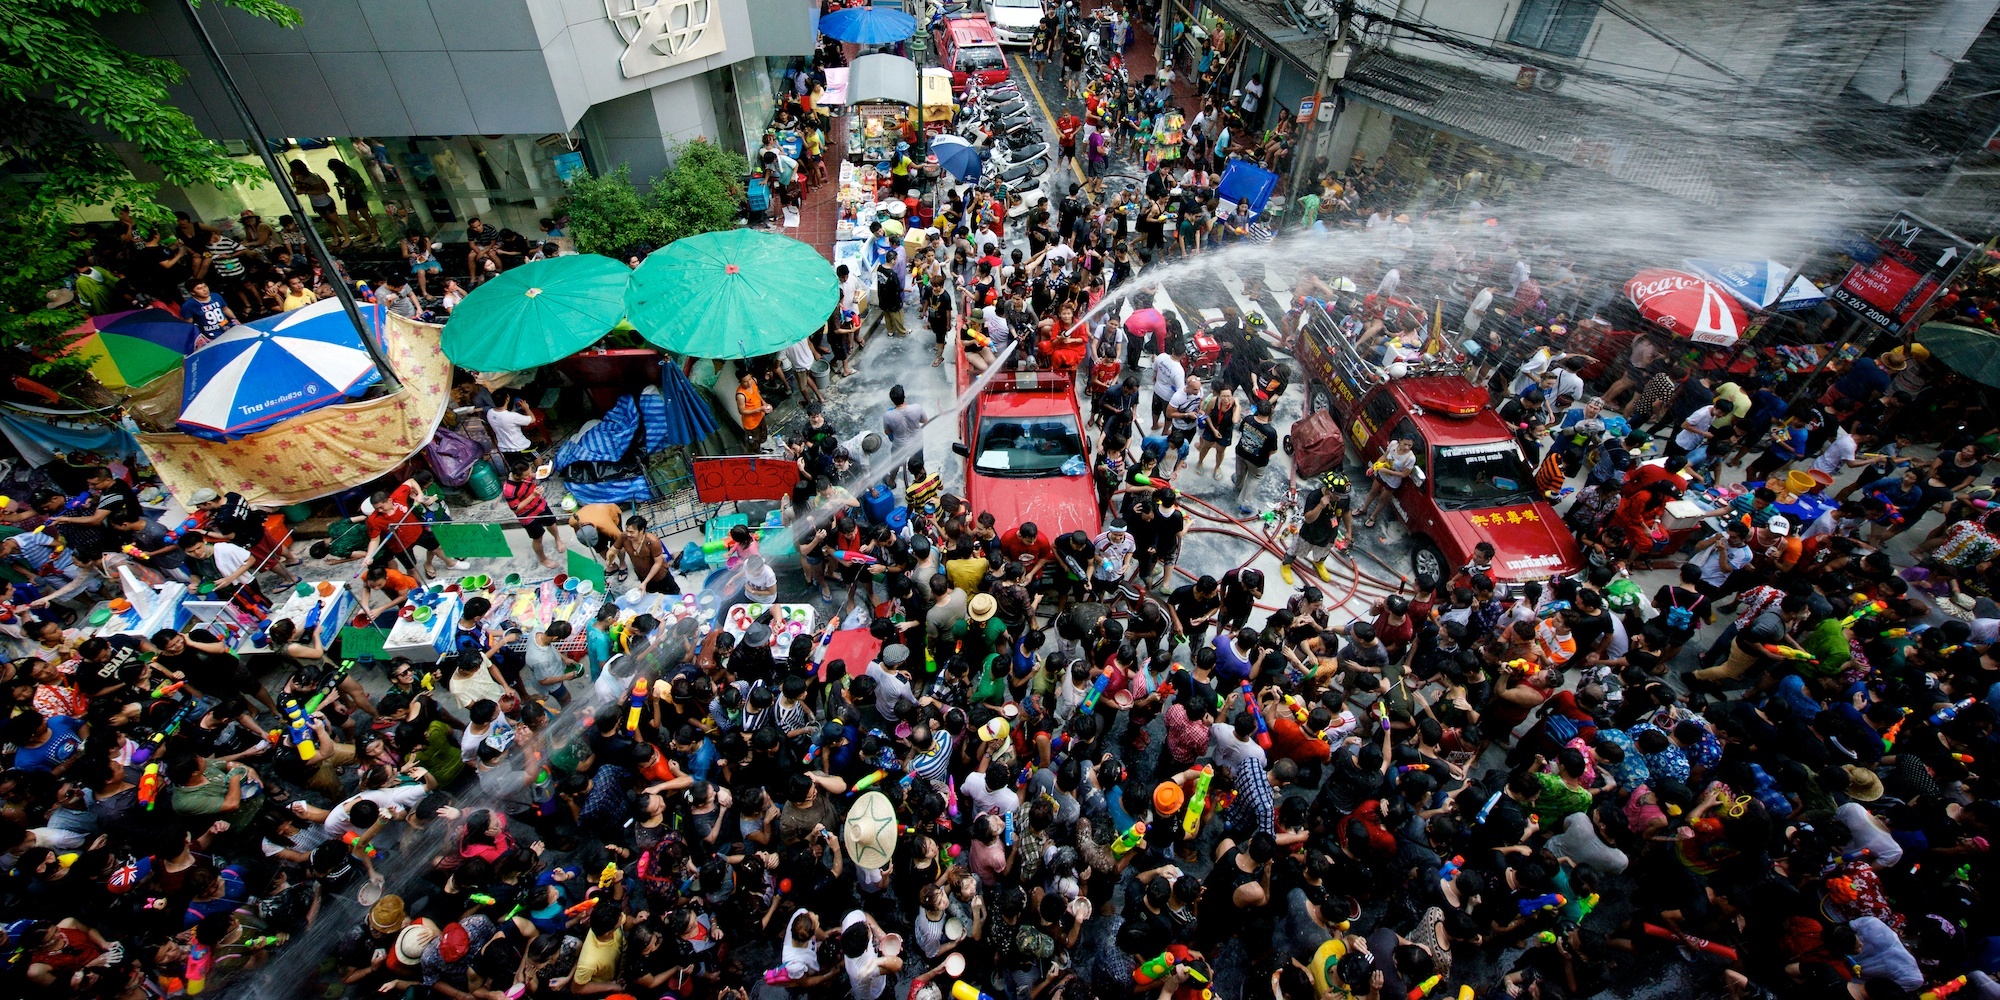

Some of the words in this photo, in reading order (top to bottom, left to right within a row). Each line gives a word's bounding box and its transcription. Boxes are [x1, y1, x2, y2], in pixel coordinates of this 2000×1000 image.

[1887, 219, 1923, 248] M
[1776, 286, 1801, 296] Cang
[205, 308, 225, 325] 98
[1835, 289, 1848, 302] 02
[1847, 296, 1867, 311] 267
[1865, 307, 1891, 327] 2000
[766, 467, 798, 488] 30
[97, 645, 134, 679] OSAKA
